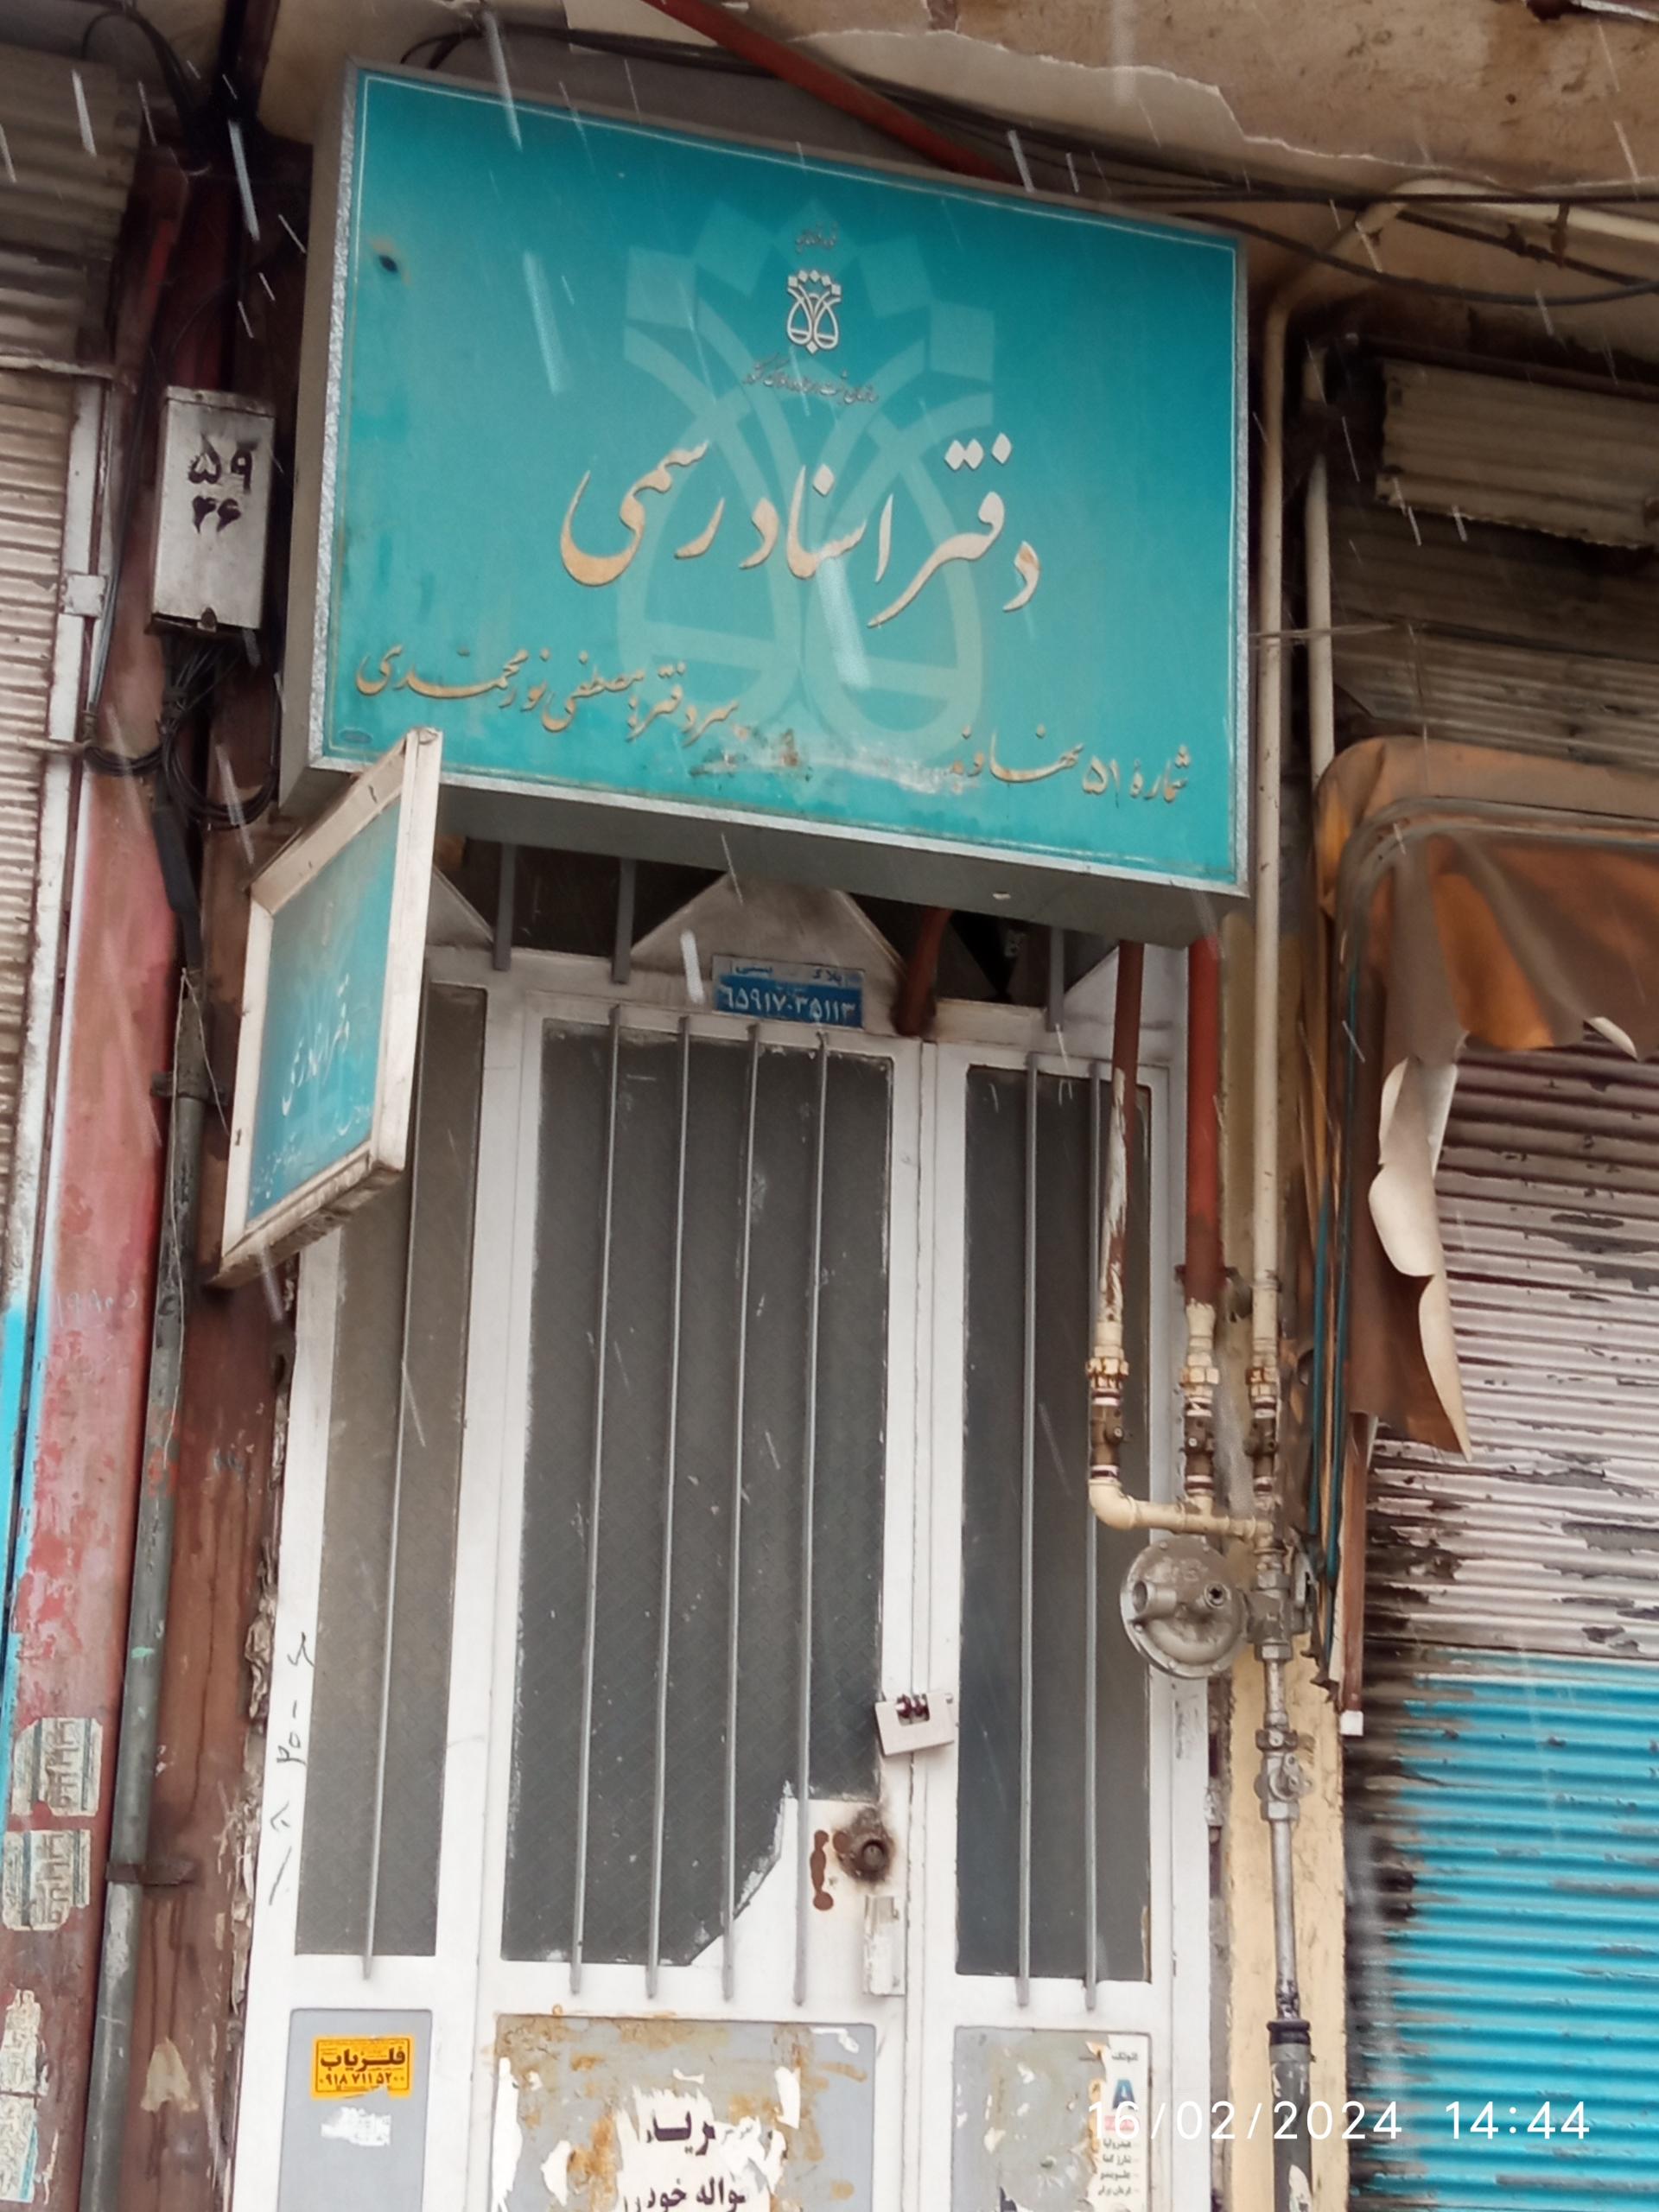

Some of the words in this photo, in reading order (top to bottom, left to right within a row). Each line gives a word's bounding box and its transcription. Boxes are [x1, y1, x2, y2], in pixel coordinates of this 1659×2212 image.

[560, 439, 725, 588] رسمی
[740, 462, 894, 584] اسناد
[867, 432, 1040, 629] دفتر
[542, 650, 646, 734] مصطفی
[320, 2045, 406, 2072] فلزیاب
